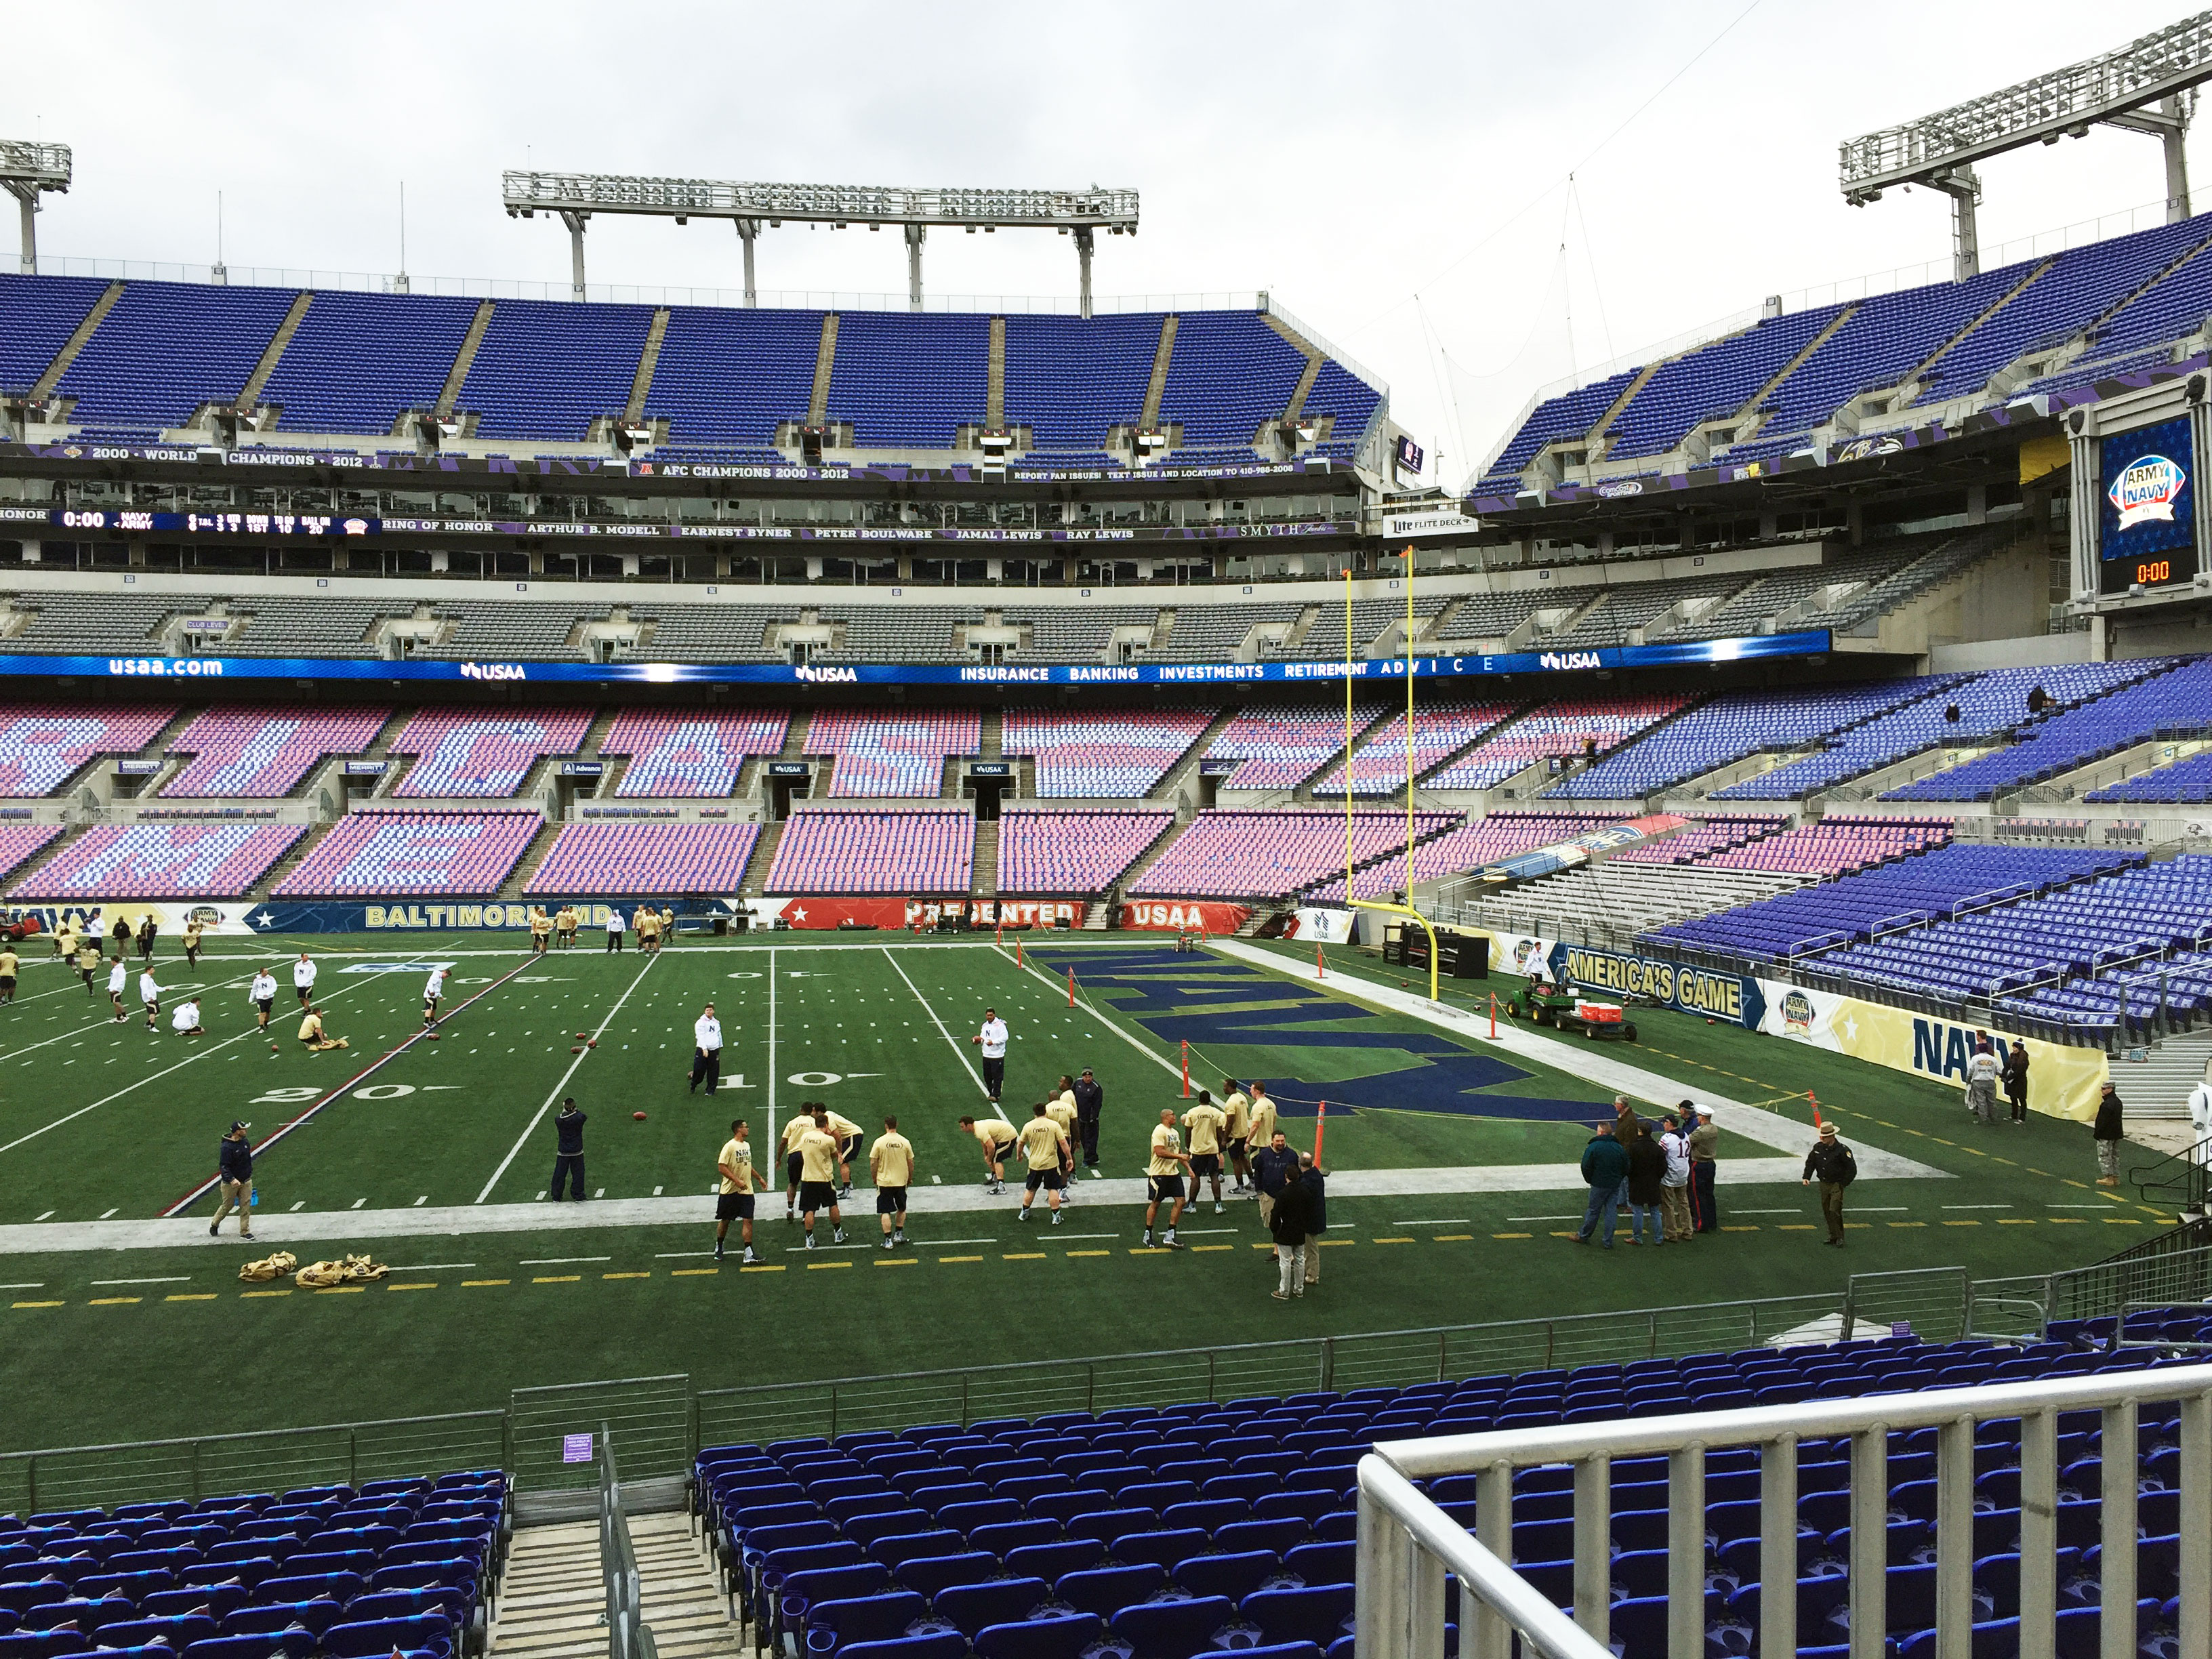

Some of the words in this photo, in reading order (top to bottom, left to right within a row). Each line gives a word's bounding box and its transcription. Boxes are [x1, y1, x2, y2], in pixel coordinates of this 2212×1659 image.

[93, 448, 129, 459] 2000
[144, 449, 197, 462] WORLD
[229, 453, 315, 465] CHAMPIONS
[333, 457, 363, 468] 2012
[663, 465, 688, 476] AFC
[693, 466, 771, 478] CHAMPIONS
[776, 468, 808, 478] 2000
[821, 468, 849, 479] 2012
[1160, 470, 1179, 478] AND
[1181, 469, 1223, 477] LOCATION
[2127, 463, 2167, 485] ARMY
[2127, 483, 2166, 504] NAVY
[64, 512, 104, 527] 0:00
[121, 512, 151, 521] NAVY
[246, 514, 269, 525] DOWN
[274, 515, 284, 525] TO
[284, 516, 295, 525] GO
[302, 516, 320, 526] BALL
[321, 517, 331, 527] ON
[121, 520, 153, 530] ARMY
[247, 524, 268, 533] 1ST
[278, 525, 292, 534] 10
[309, 525, 323, 535] 20
[382, 520, 417, 530] RING
[422, 521, 440, 531] OF
[445, 521, 493, 532] HONOR
[527, 524, 584, 534] ARTHUR
[589, 525, 602, 535] B.
[606, 525, 660, 535] MODELL
[1240, 525, 1299, 536] SMYTH
[1391, 520, 1413, 534] Lite
[1414, 520, 1437, 529] FLITE
[1440, 518, 1462, 527] DECK
[681, 527, 743, 537] EARNEST
[747, 529, 792, 537] BYNER
[815, 529, 857, 539] PETER
[861, 529, 933, 539] BOULWARE
[956, 531, 998, 539] JAMAL
[1002, 531, 1042, 539] LEWIS
[1066, 531, 1090, 539] RAY
[1094, 530, 1134, 539] LEWIS
[2137, 561, 2169, 583] 0:00
[109, 658, 222, 675] usaa.com
[1561, 652, 1600, 670] USAA
[482, 665, 526, 679] USAA
[816, 668, 857, 682] USAA
[961, 668, 1049, 680] INSURANCE
[1069, 668, 1139, 680] BANKING
[1160, 665, 1264, 679] INVESTMENTS
[1284, 662, 1368, 677] RETIREMENT
[1134, 905, 1204, 927] USAA
[1314, 930, 1329, 940] USAA
[1566, 948, 1675, 1004] AMERICA'S
[1679, 968, 1742, 1021] GAME
[1787, 995, 1809, 1009] ARMY
[1787, 1009, 1809, 1025] NAVY
[1677, 1141, 1691, 1158] 12
